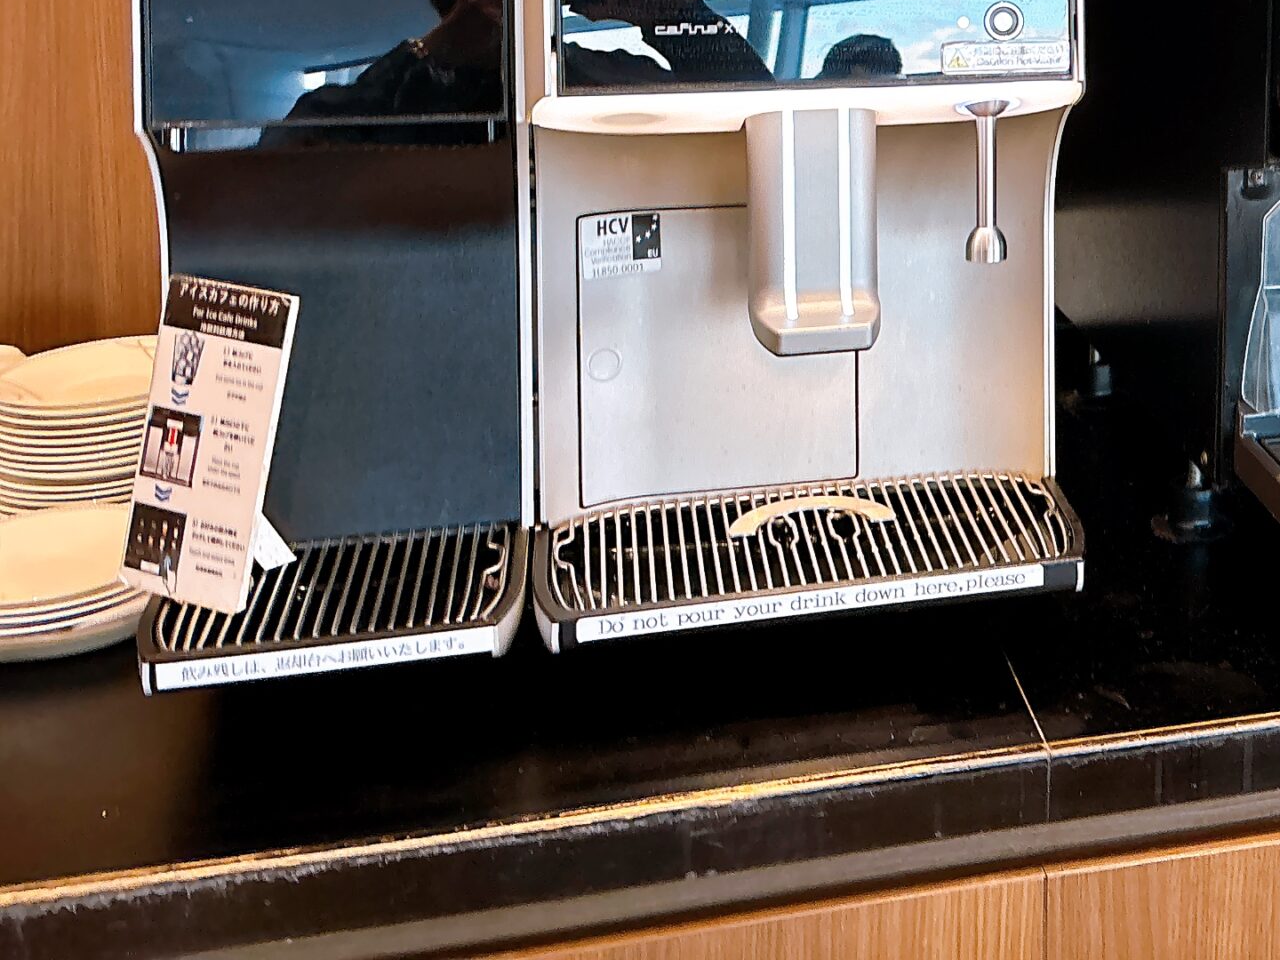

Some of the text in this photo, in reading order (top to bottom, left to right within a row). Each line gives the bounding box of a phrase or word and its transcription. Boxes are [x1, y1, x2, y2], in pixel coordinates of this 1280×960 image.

[597, 216, 629, 237] HCV
[647, 247, 659, 258] EU
[598, 616, 624, 636] Do
[632, 612, 669, 631] not
[676, 606, 726, 628] pour
[733, 601, 782, 623] your
[790, 590, 847, 612] drink
[854, 584, 905, 604] down
